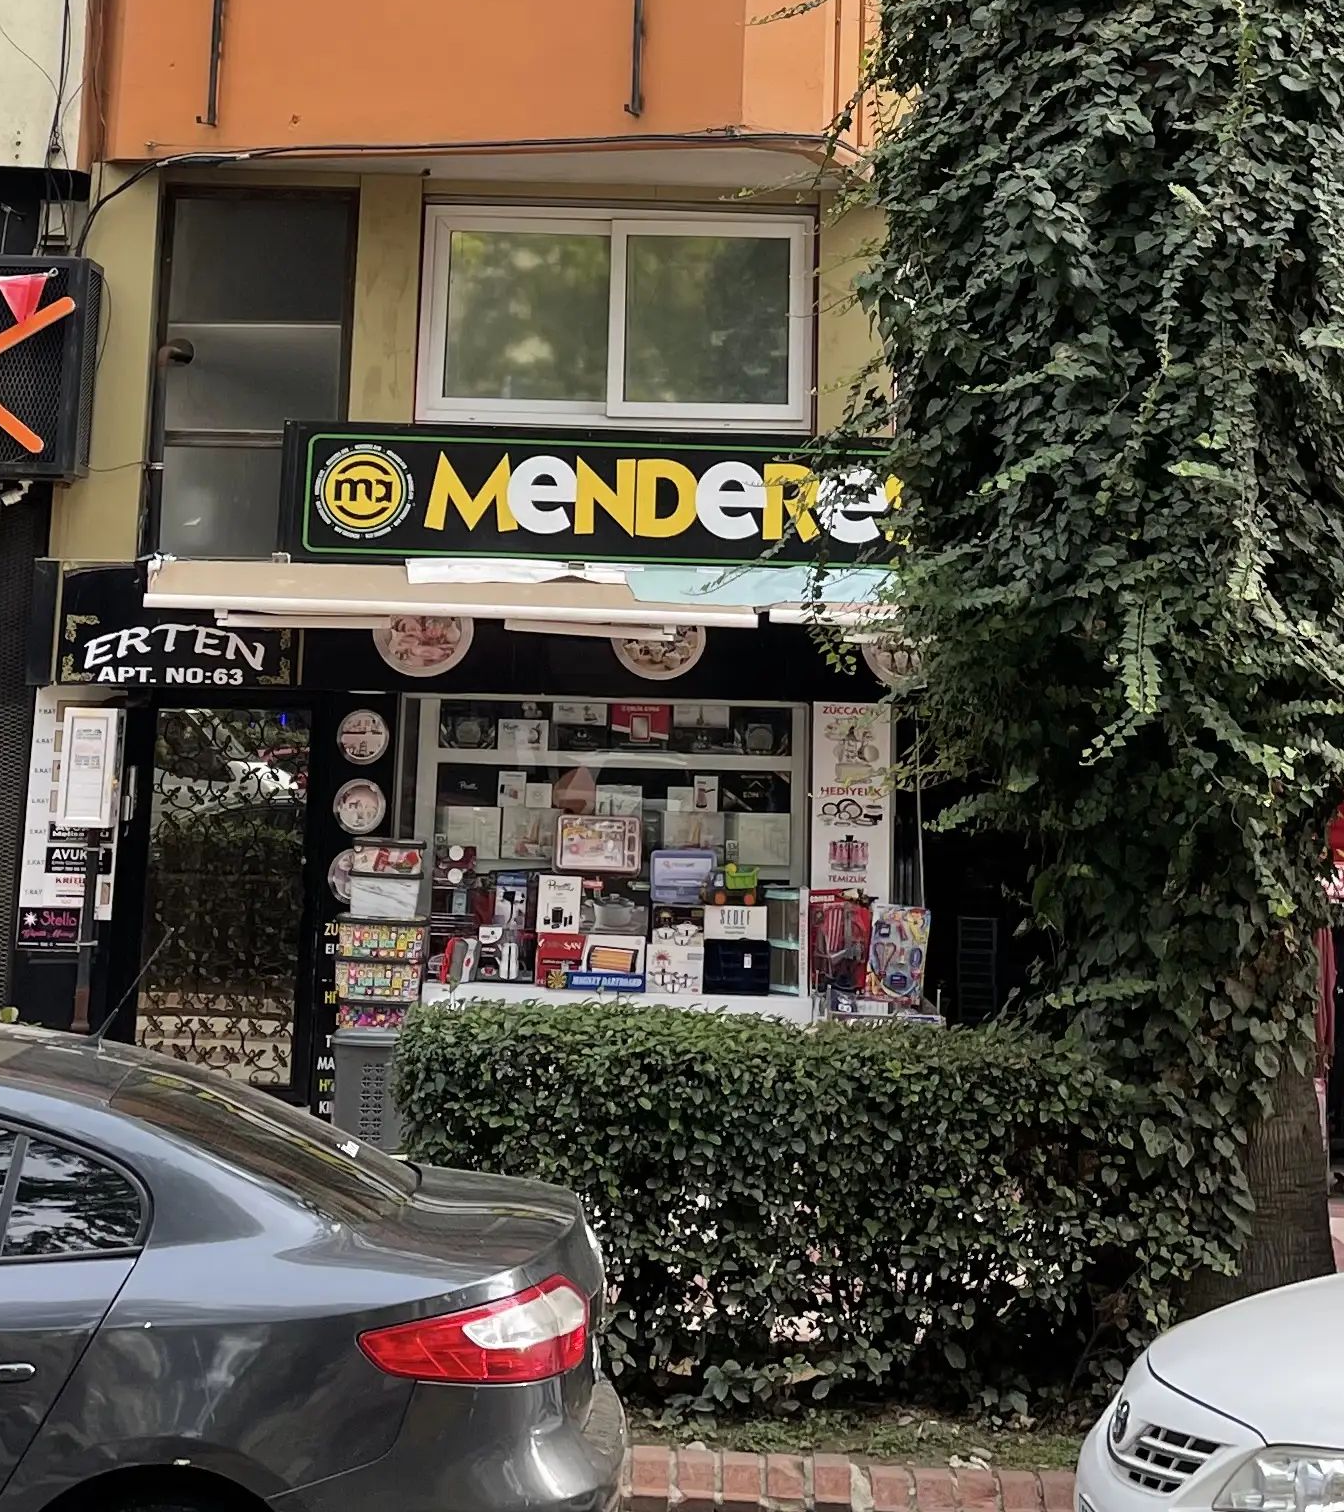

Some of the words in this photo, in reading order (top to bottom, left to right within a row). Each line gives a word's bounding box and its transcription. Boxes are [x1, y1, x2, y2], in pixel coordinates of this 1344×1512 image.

[83, 623, 265, 671] ERTEN
[97, 666, 157, 684] APT.
[165, 667, 244, 685] NO:63
[52, 847, 106, 862] AVUKT
[720, 908, 751, 926] SEDEF
